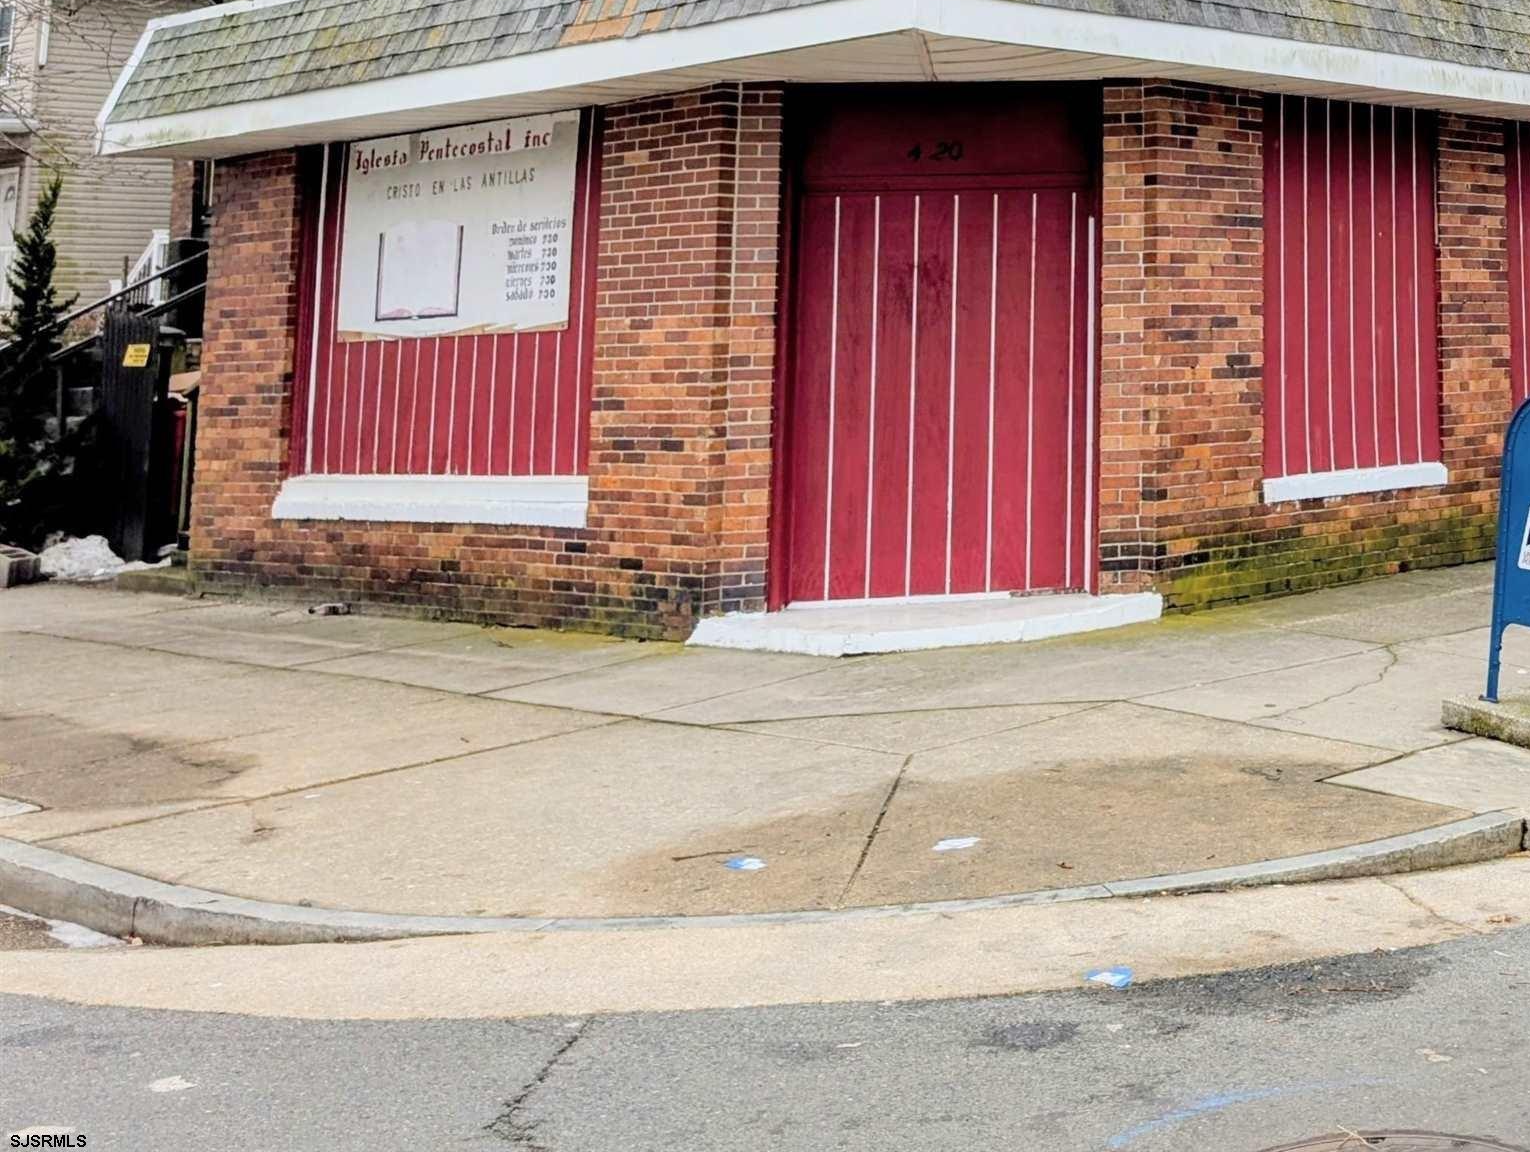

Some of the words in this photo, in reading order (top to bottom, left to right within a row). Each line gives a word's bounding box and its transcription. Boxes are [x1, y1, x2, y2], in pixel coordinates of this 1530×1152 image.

[355, 148, 407, 174] Iglesia
[420, 128, 511, 161] Pentecostal
[387, 183, 421, 200] CRISTO
[432, 180, 445, 195] EN
[453, 175, 472, 192] LAS
[481, 168, 536, 188] ANTILLAS
